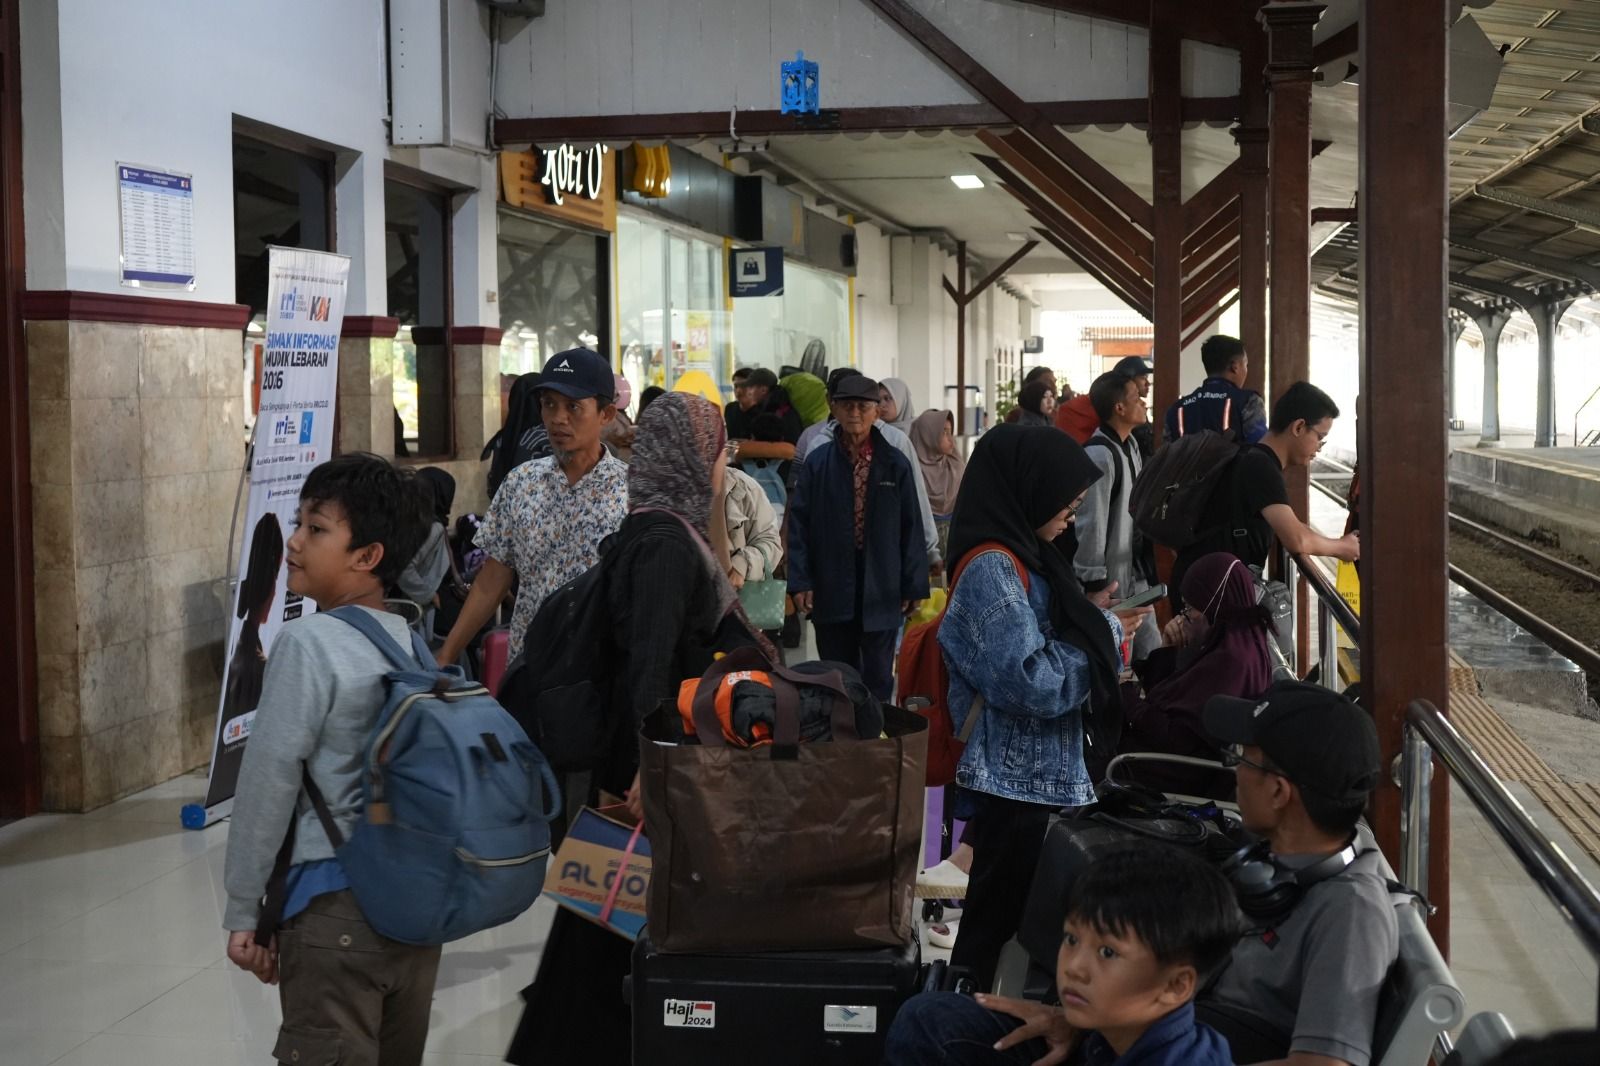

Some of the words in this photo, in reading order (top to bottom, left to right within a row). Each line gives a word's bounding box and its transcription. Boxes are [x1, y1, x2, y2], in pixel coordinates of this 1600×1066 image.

[267, 331, 293, 349] SIMAK
[293, 333, 337, 350] INFORMASI
[264, 351, 290, 367] MUDIK
[291, 351, 329, 367] LEBARAN
[666, 1002, 695, 1025] Haji
[687, 1017, 712, 1026] 2024
